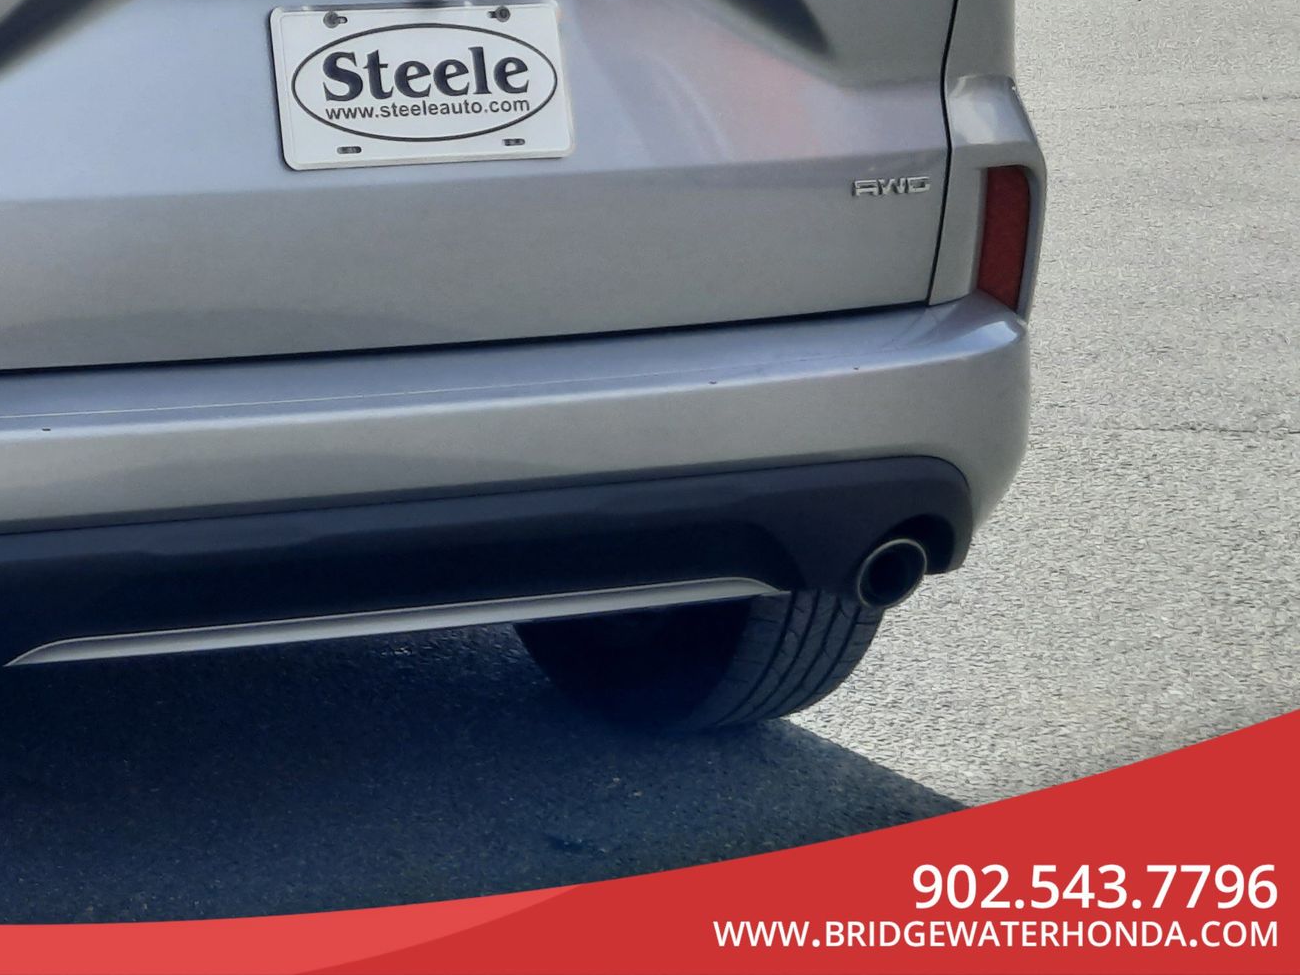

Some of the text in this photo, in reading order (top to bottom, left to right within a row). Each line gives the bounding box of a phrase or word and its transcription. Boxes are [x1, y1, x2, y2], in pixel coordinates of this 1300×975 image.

[322, 46, 529, 102] Steele
[325, 99, 530, 120] www.steeleauto.com
[852, 176, 931, 197] AWD
